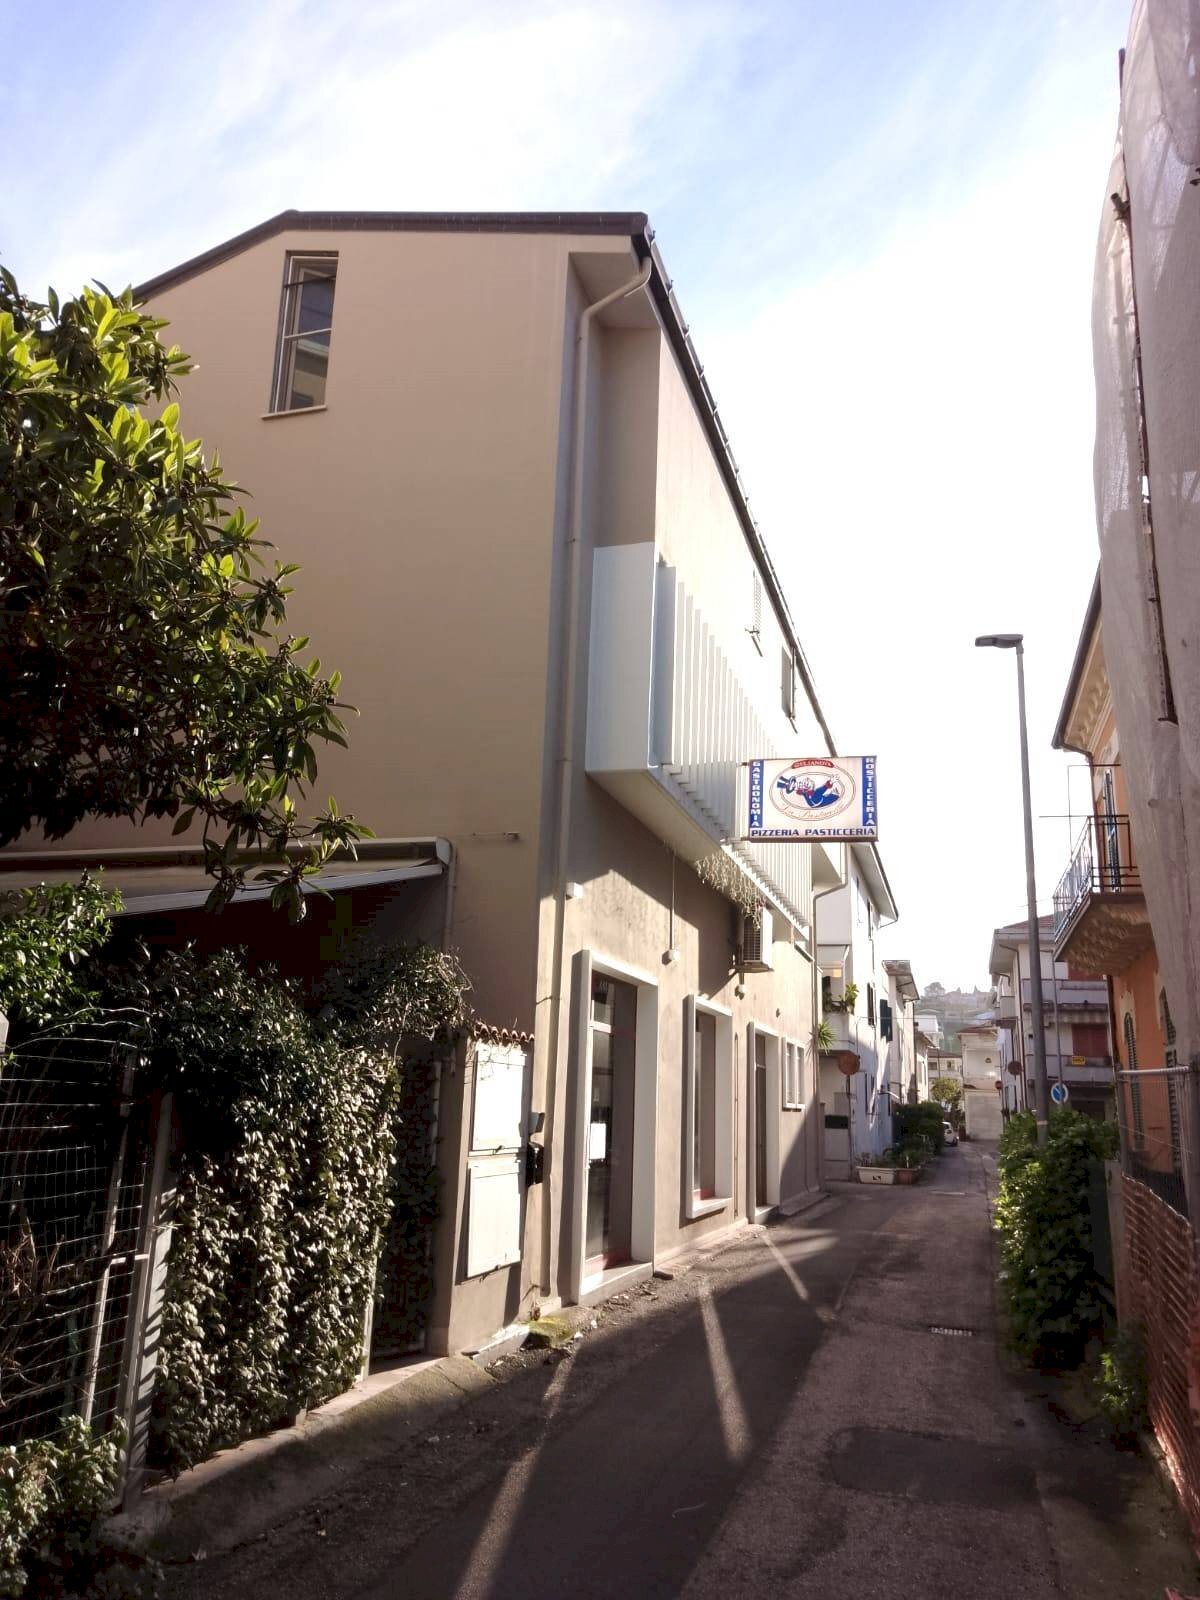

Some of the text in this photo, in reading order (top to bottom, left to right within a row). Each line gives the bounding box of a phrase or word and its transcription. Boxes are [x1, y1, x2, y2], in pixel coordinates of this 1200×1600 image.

[750, 761, 761, 827] GASTRONOMIA
[865, 757, 875, 825] ROSTICCERIA
[751, 827, 875, 837] PIZZERIA PASTICCERIA
